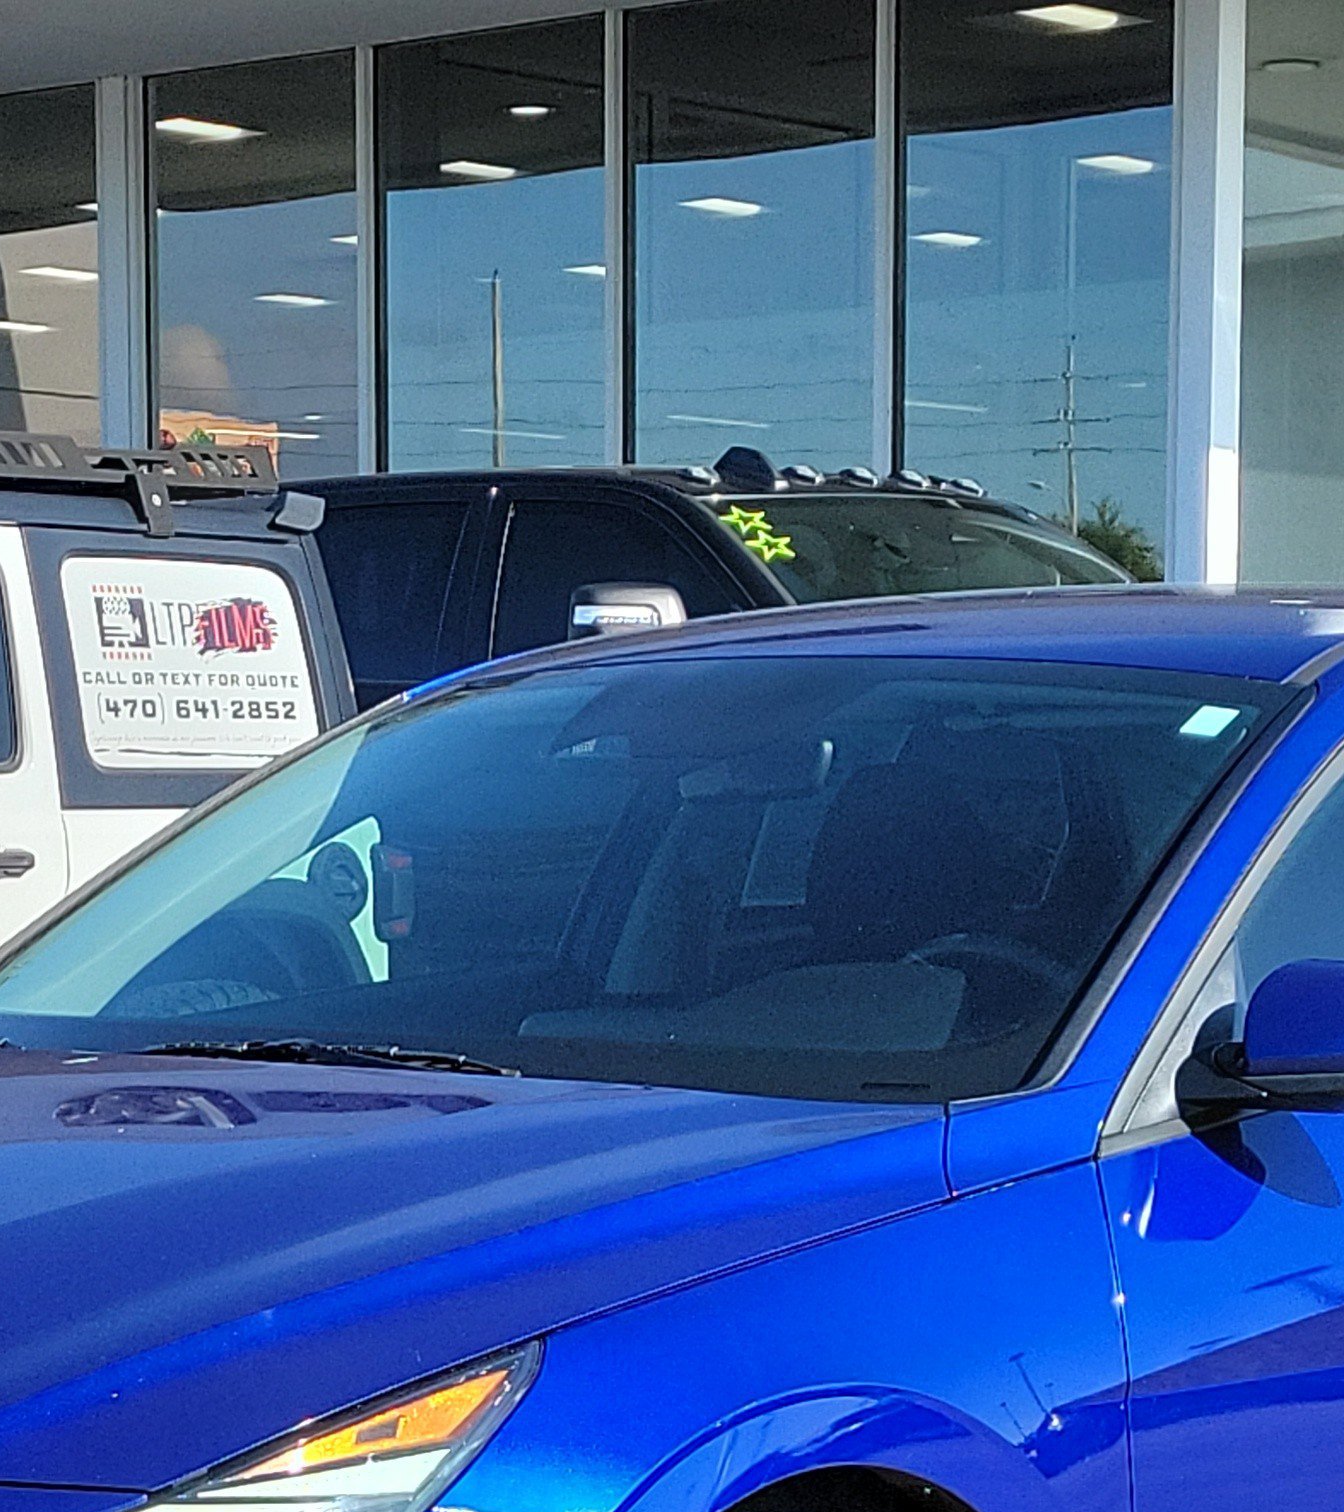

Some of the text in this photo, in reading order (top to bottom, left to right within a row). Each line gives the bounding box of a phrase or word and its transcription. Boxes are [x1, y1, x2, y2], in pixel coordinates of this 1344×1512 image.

[150, 601, 196, 646] LTP
[82, 671, 300, 690] CALL OR TEXT FOR QUOTE
[97, 692, 298, 725] (470) 641-2852
